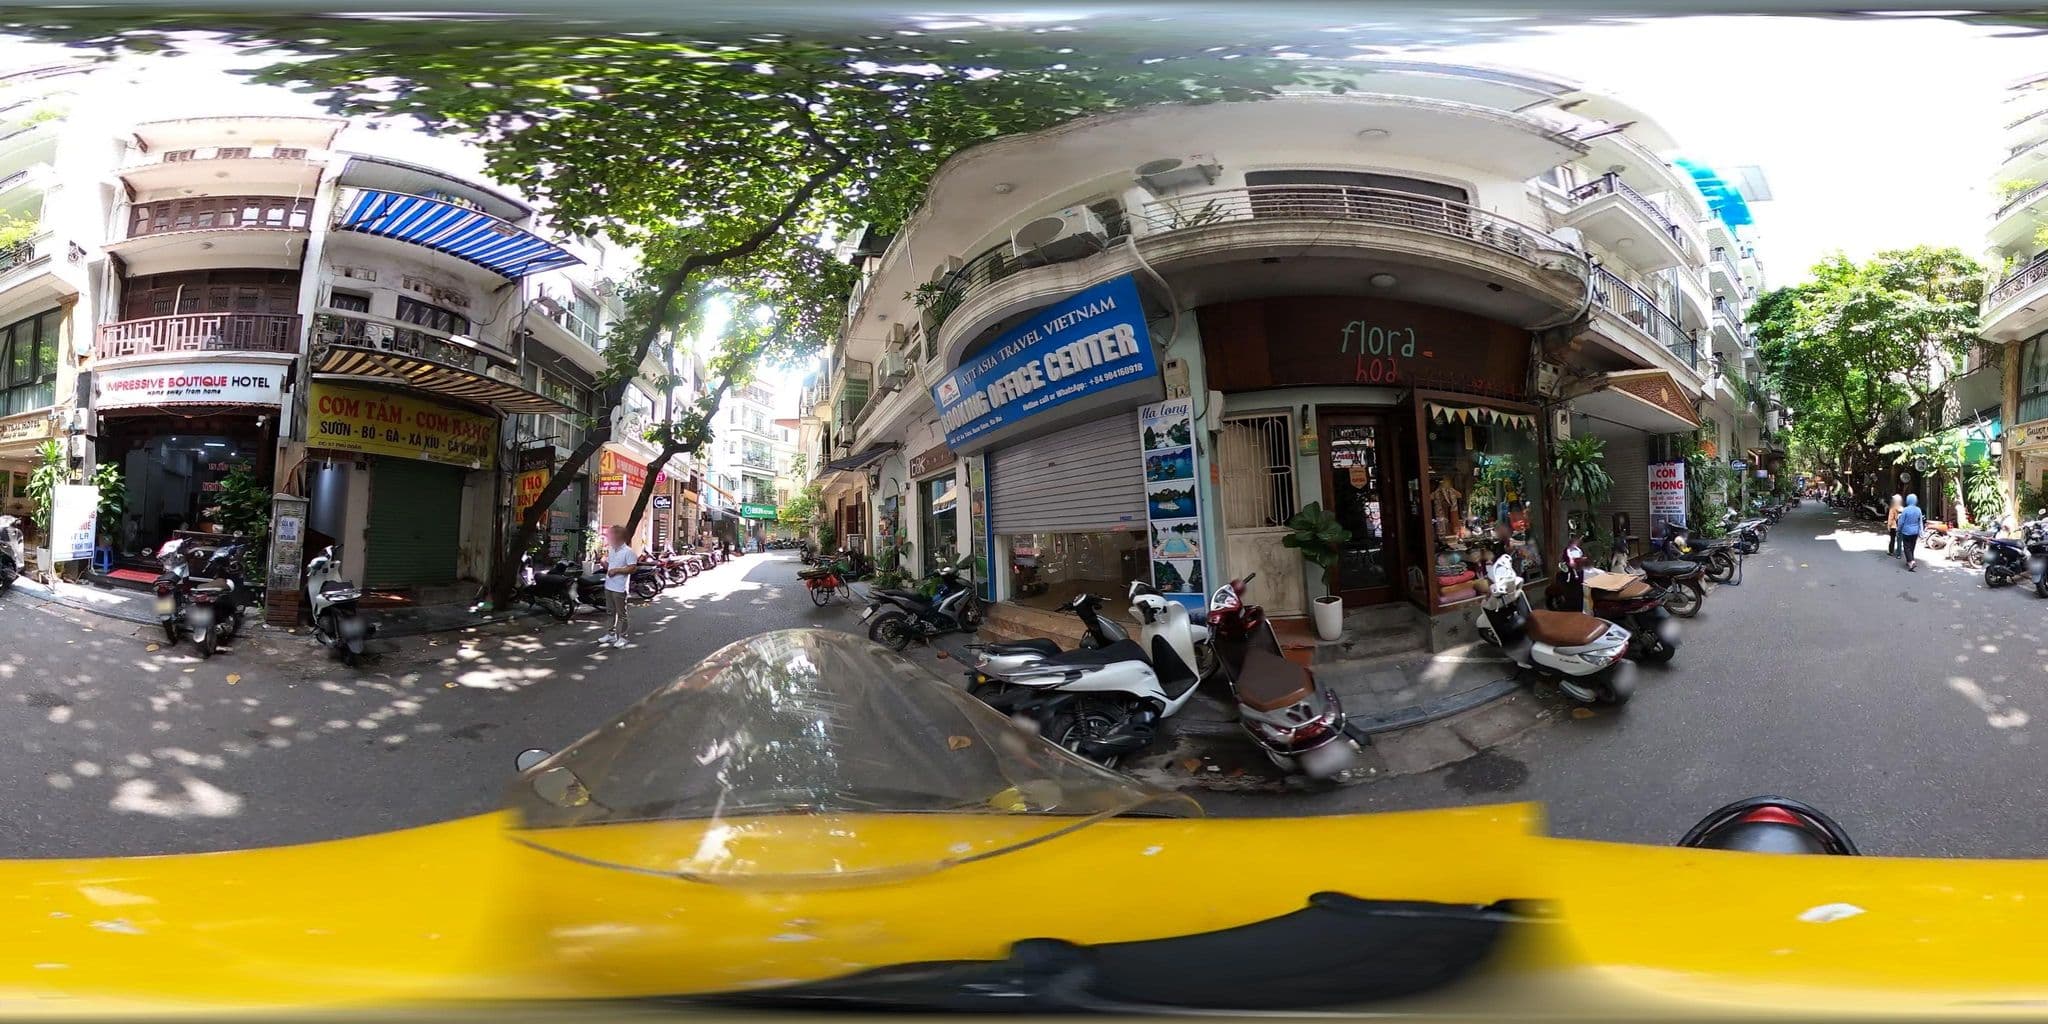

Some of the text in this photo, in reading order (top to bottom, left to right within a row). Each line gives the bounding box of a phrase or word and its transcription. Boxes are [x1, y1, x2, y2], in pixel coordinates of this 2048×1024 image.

[978, 356, 998, 375] ASIA
[998, 329, 1043, 361] TRAVEL
[1043, 296, 1117, 335] VIETNAM
[1341, 320, 1415, 358] flora
[106, 376, 270, 391] IMPRESSIVE BOUTIQUE HOTEL
[941, 323, 1140, 434] BOOKING OFFICE CENTER
[1355, 353, 1398, 382] hoa
